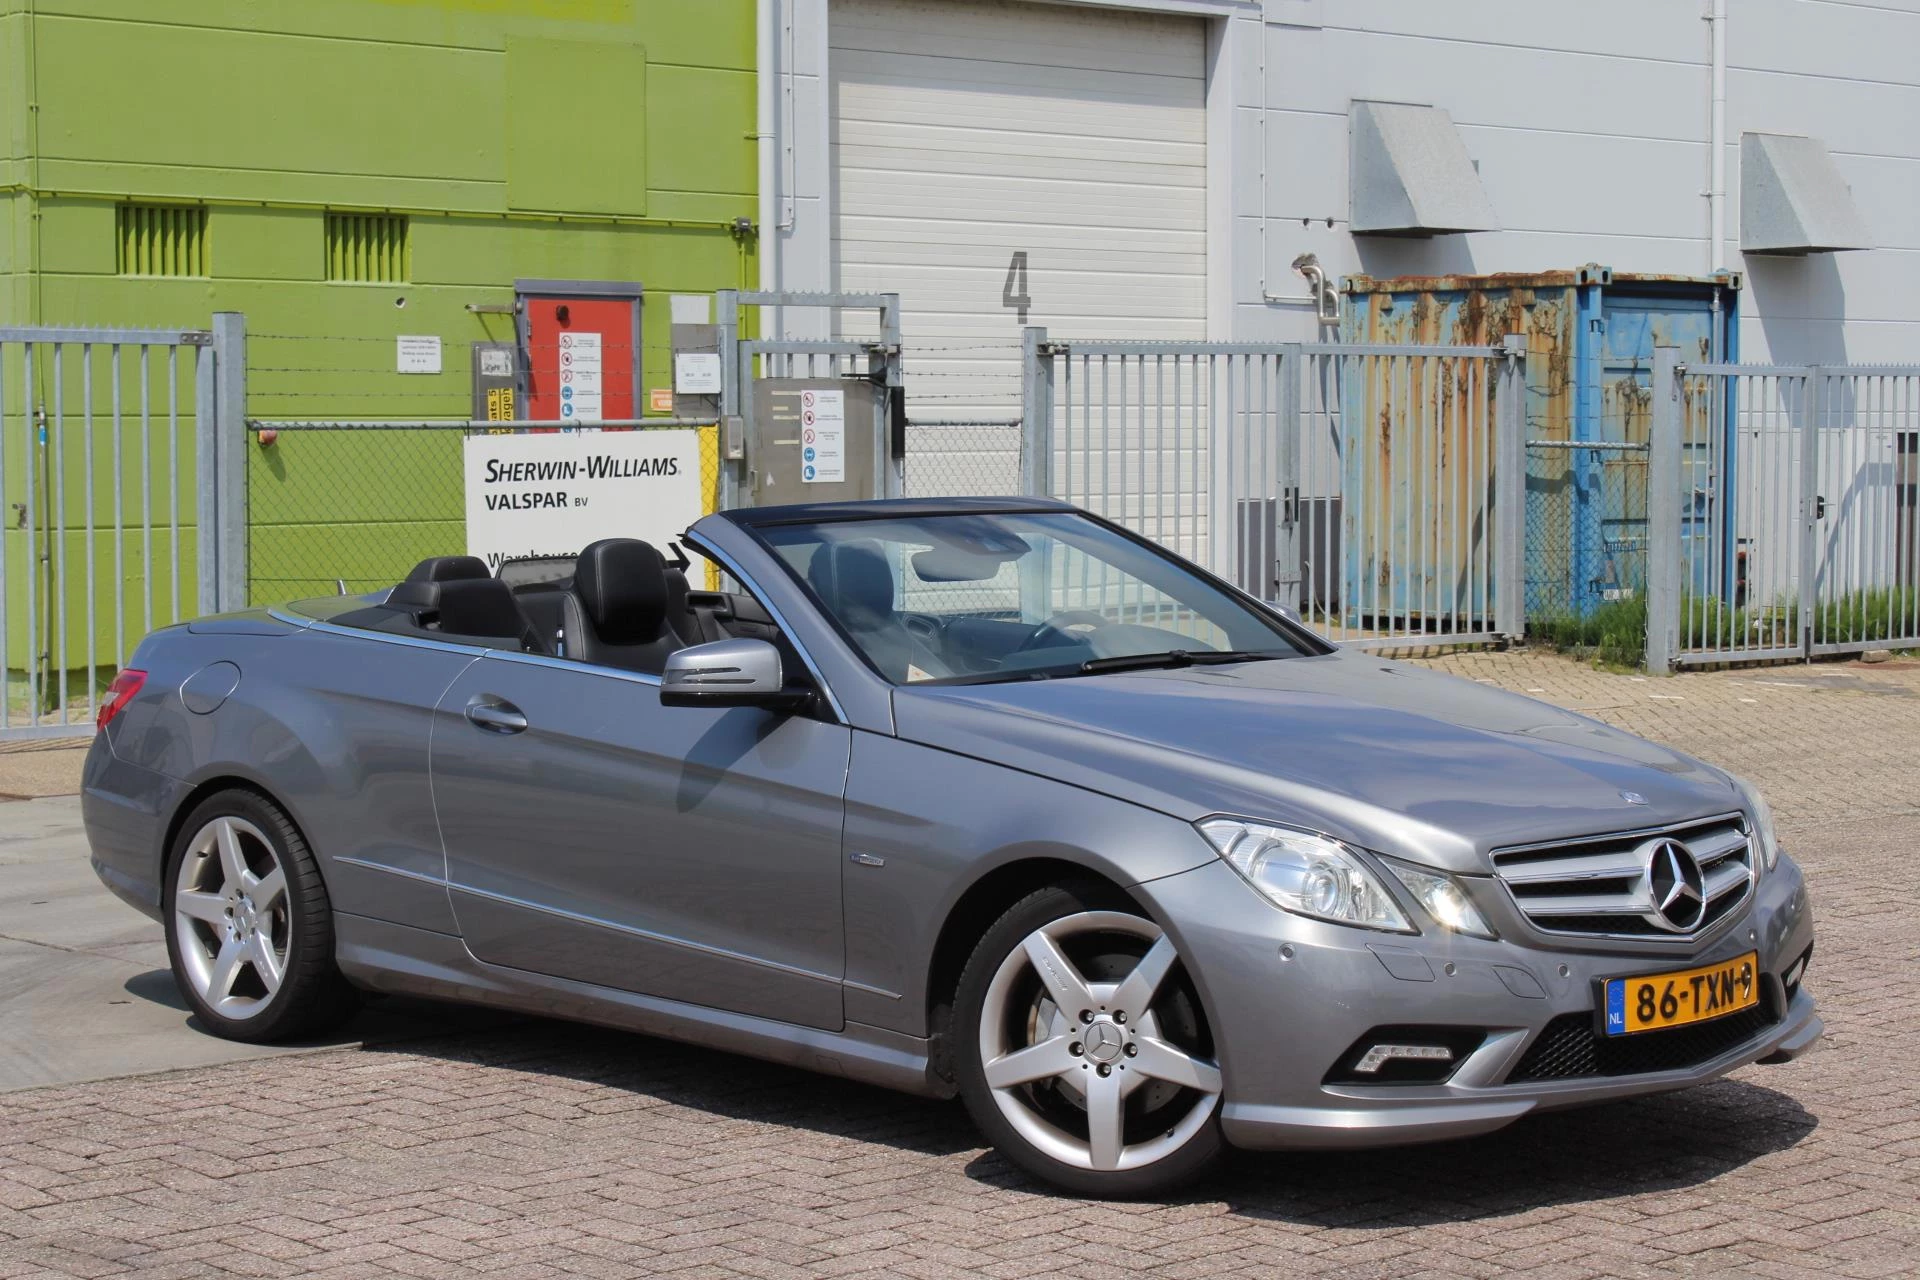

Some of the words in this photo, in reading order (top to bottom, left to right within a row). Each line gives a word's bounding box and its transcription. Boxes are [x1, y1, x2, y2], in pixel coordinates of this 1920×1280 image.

[1003, 251, 1031, 324] 4
[485, 455, 678, 483] SHERWIN-WILLIAMS
[485, 491, 568, 510] VALSPAR
[574, 497, 588, 507] BV
[1636, 962, 1753, 1023] 86-TXN-9
[1609, 1013, 1623, 1025] NL
